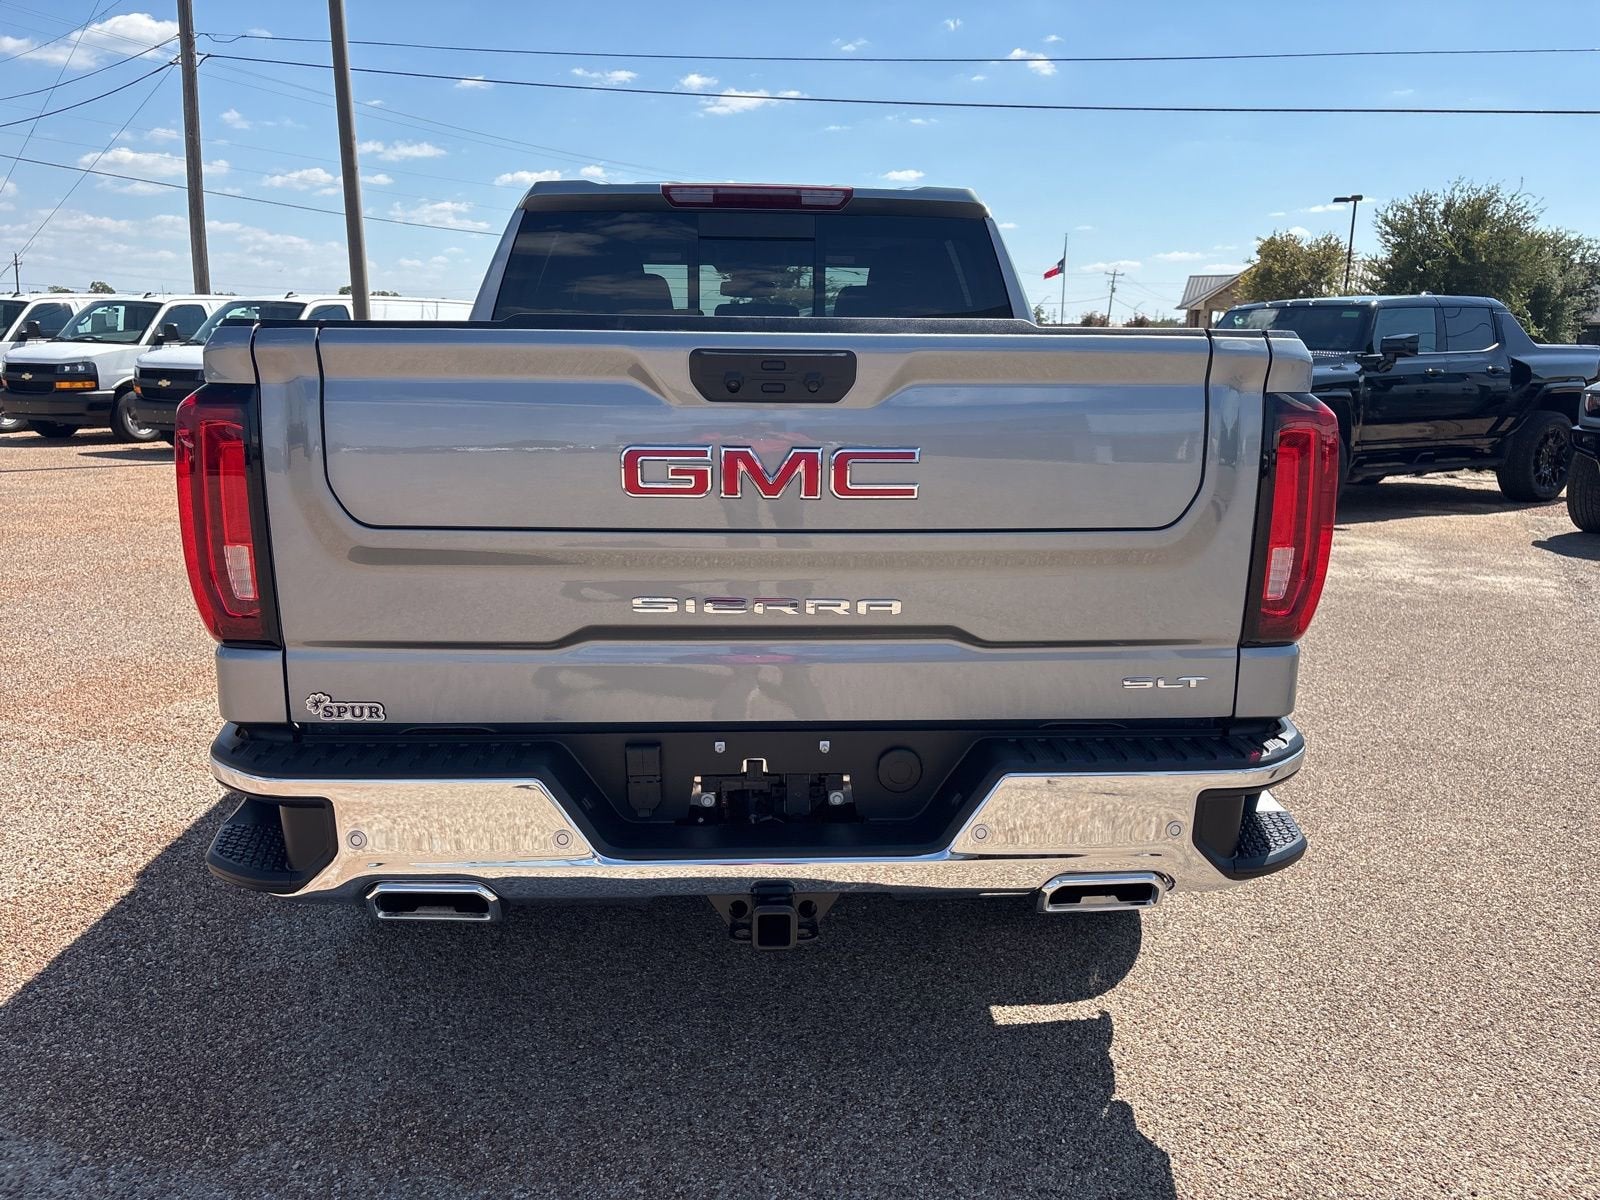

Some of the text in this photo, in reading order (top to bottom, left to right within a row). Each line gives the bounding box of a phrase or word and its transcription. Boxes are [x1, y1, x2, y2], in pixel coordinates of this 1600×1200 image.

[621, 446, 921, 499] GMC
[631, 597, 902, 615] SIERRA
[1122, 676, 1208, 688] SLT
[322, 704, 382, 719] SPUR
